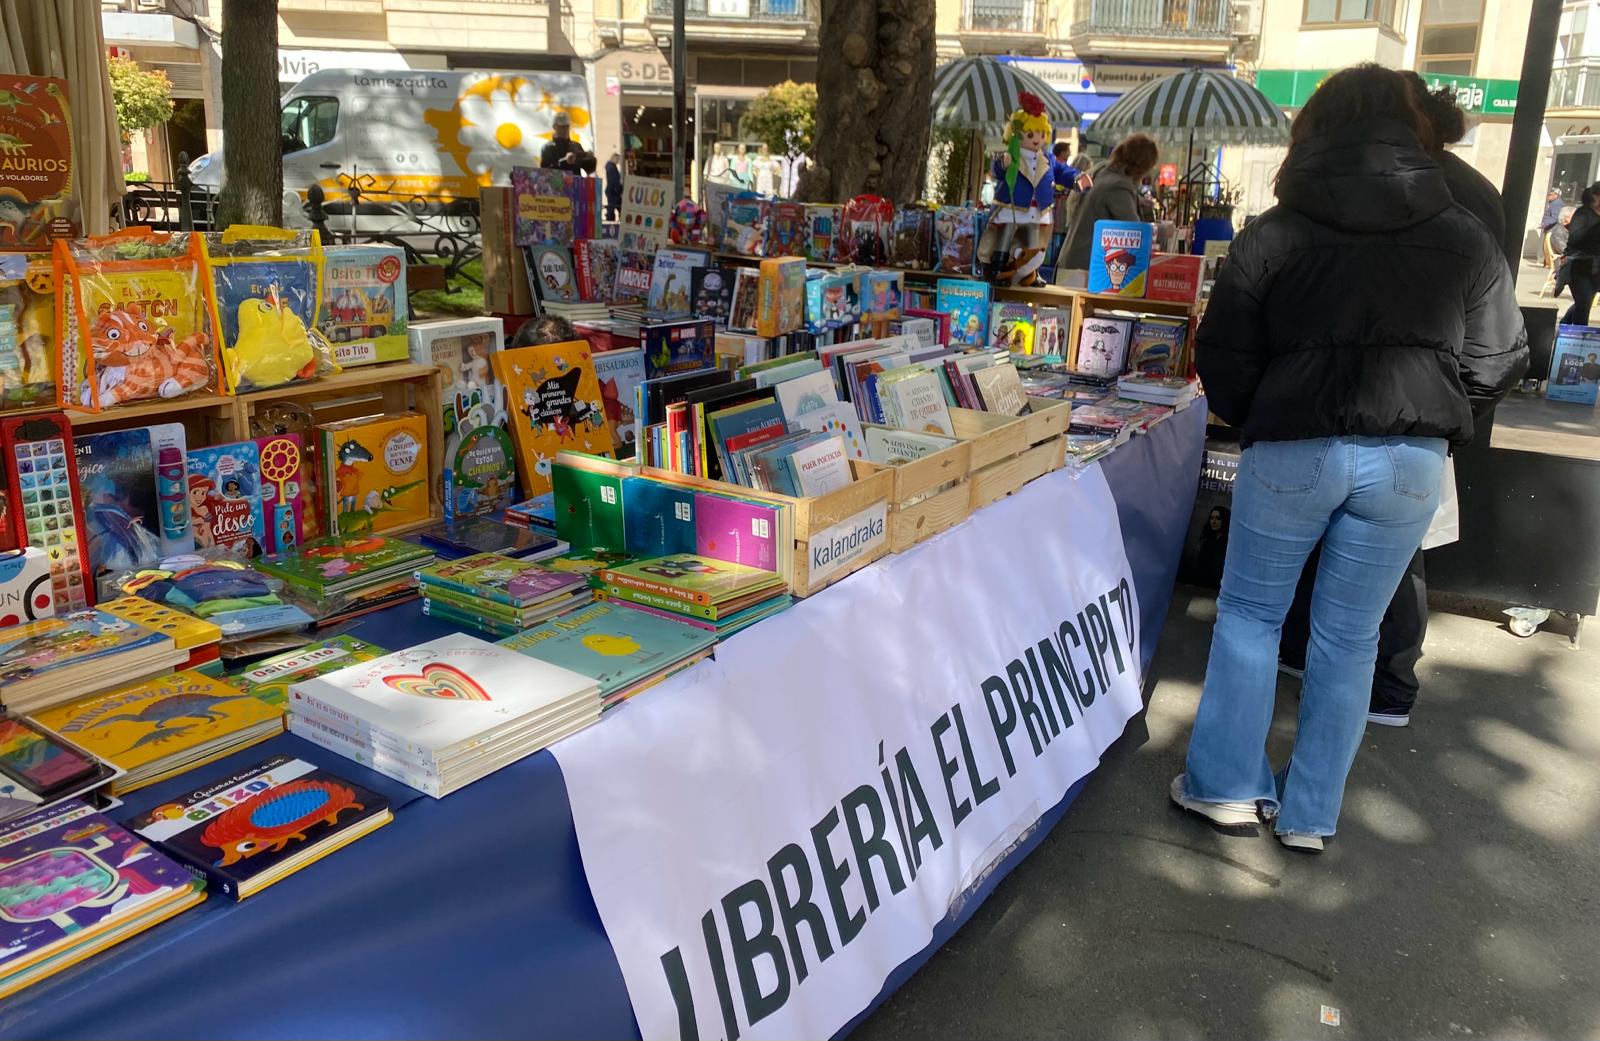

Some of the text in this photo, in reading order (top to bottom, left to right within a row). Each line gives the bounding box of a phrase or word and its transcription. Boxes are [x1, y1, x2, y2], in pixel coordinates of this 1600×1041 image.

[1096, 72, 1138, 82] Apuestas
[354, 75, 448, 97] lamezquita
[2, 158, 68, 171] AURIOS
[628, 186, 666, 207] CULOS
[1103, 237, 1140, 247] WALLY?
[331, 267, 376, 280] Osito Ti
[620, 268, 650, 289] MARVEL
[122, 287, 133, 297] El
[334, 345, 369, 357] sito Tito
[595, 358, 639, 374] BISAURIOS
[547, 380, 560, 391] Mis
[541, 390, 566, 400] primeros
[546, 396, 572, 409] grandes
[540, 408, 562, 418] clásicos
[890, 440, 919, 452] ADIVINA
[475, 455, 493, 465] ESTOS
[215, 503, 247, 515] Pide un
[213, 513, 256, 536] deseo
[252, 649, 334, 678] Osito Tito
[58, 683, 214, 733] DINOSAURIOS
[660, 576, 1135, 1041] LIBRERÍA EL PRINCIPITO
